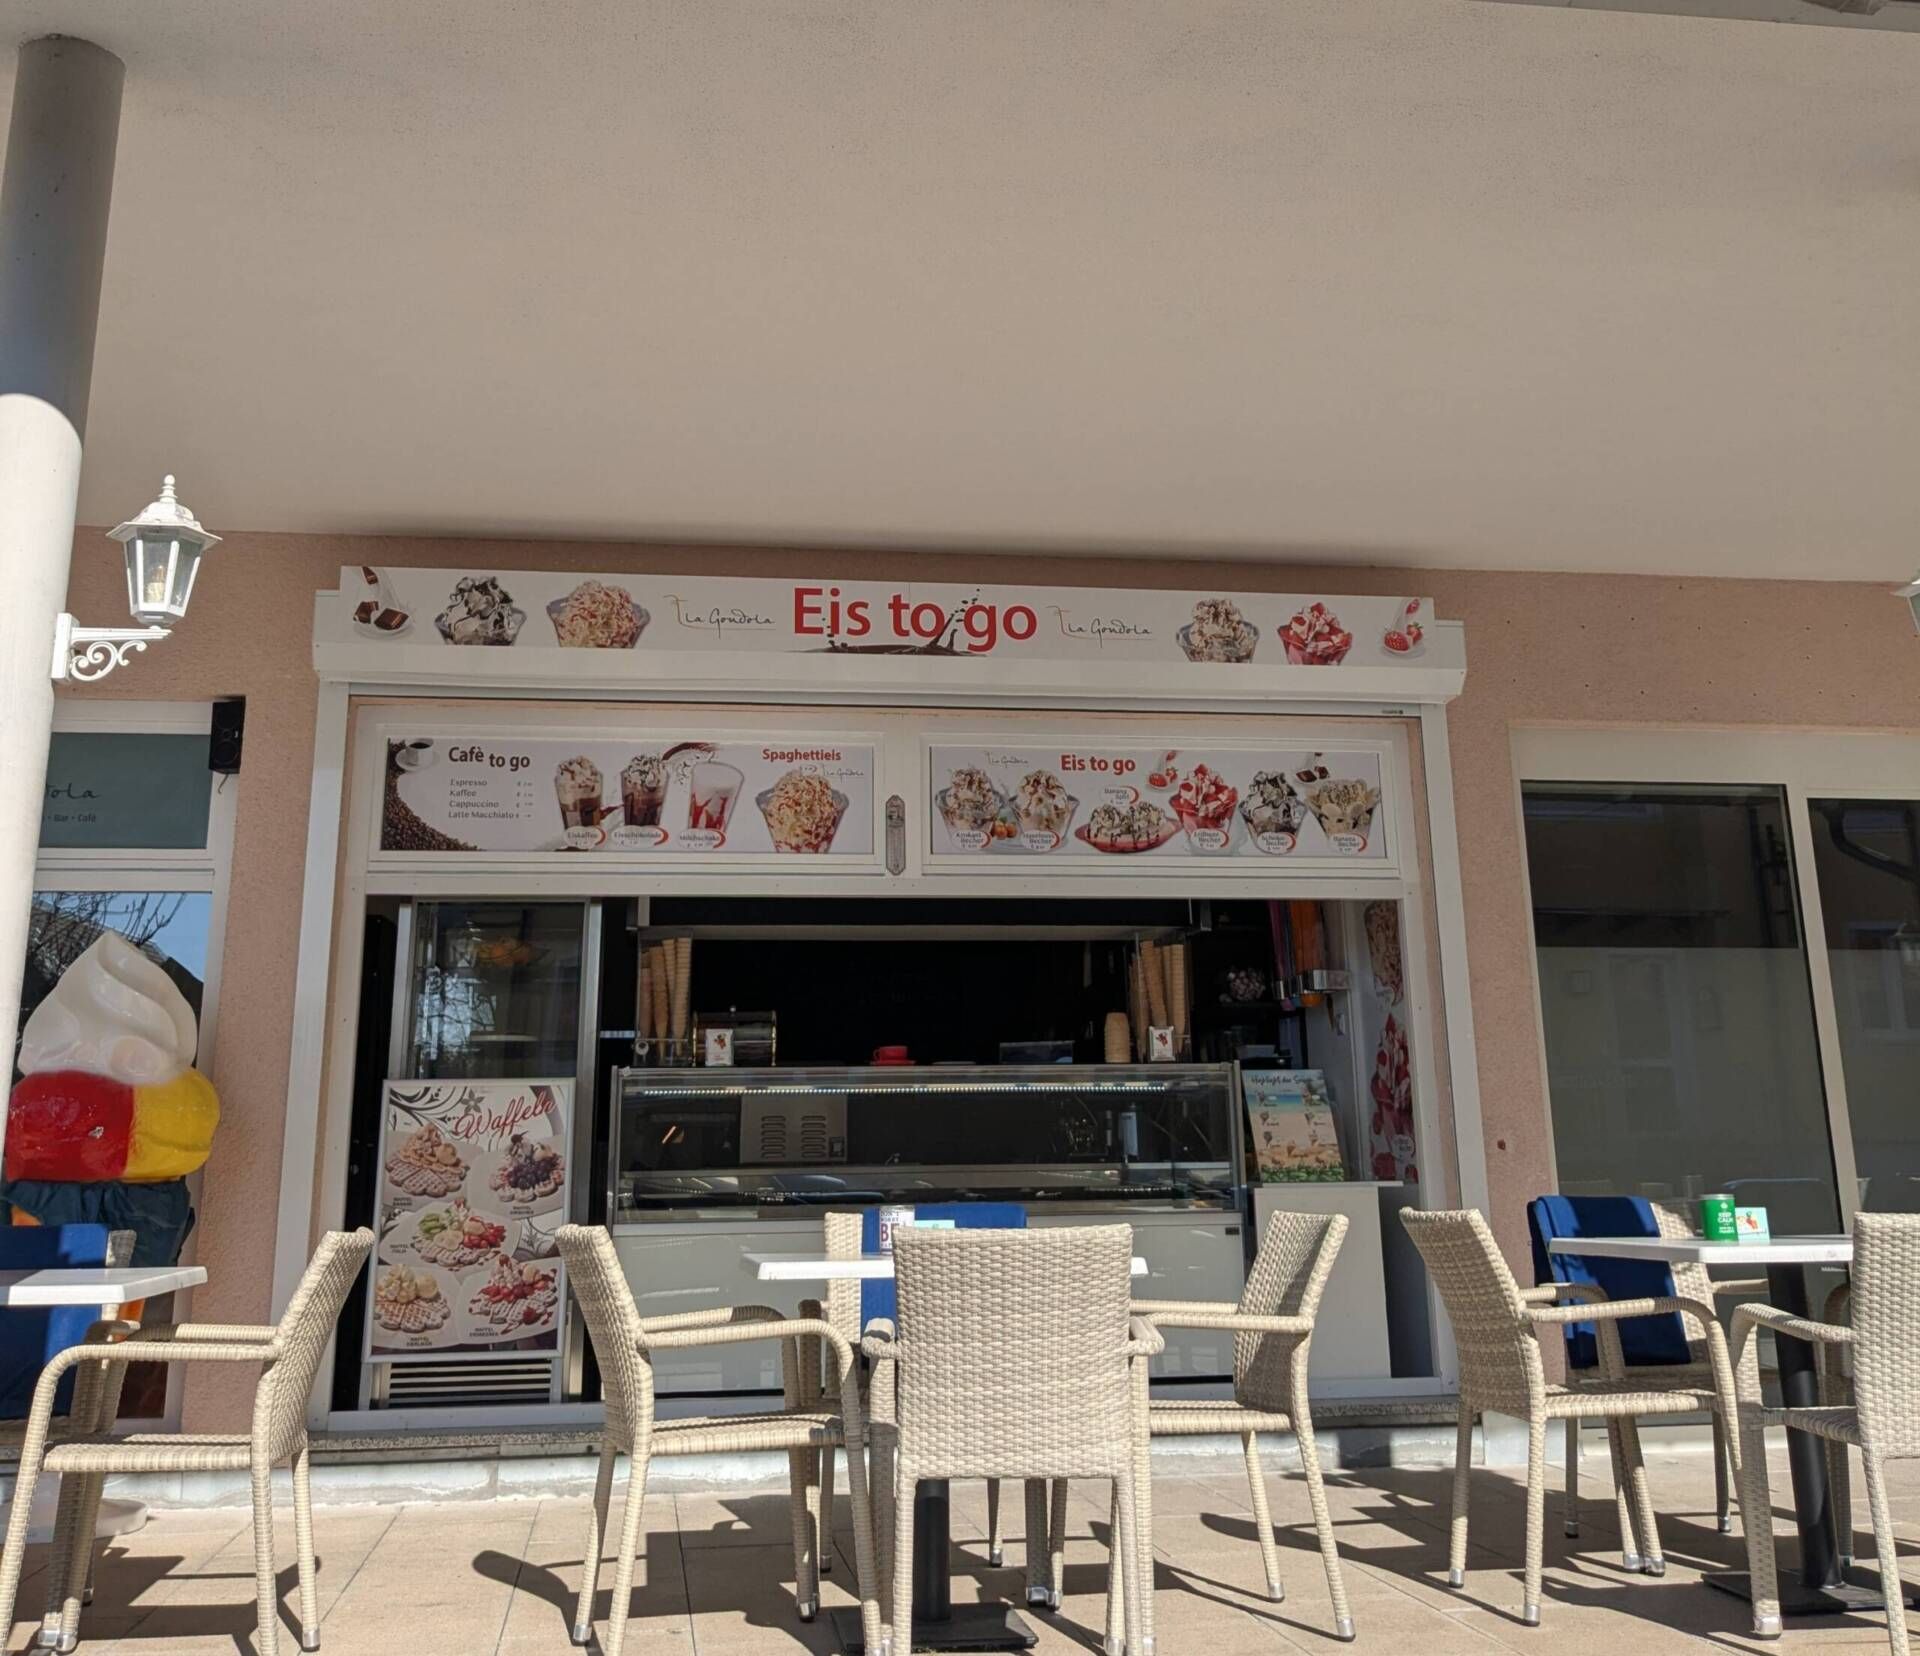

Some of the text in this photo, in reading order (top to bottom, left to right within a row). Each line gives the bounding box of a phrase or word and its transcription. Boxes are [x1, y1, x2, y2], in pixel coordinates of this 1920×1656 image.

[708, 607, 776, 640] Gondola
[794, 587, 1038, 653] Eis to go
[1090, 617, 1152, 649] Gondola
[488, 753, 507, 768] to
[509, 755, 532, 772] go
[761, 747, 842, 763] Spaghettieis
[1060, 754, 1137, 776] Eis to go
[450, 778, 488, 788] Espresso
[449, 789, 478, 797] Kaffee
[449, 800, 500, 809] Cappuccino
[448, 811, 470, 819] Latte
[471, 811, 514, 819] Macchiato
[451, 1089, 555, 1139] Waffeln
